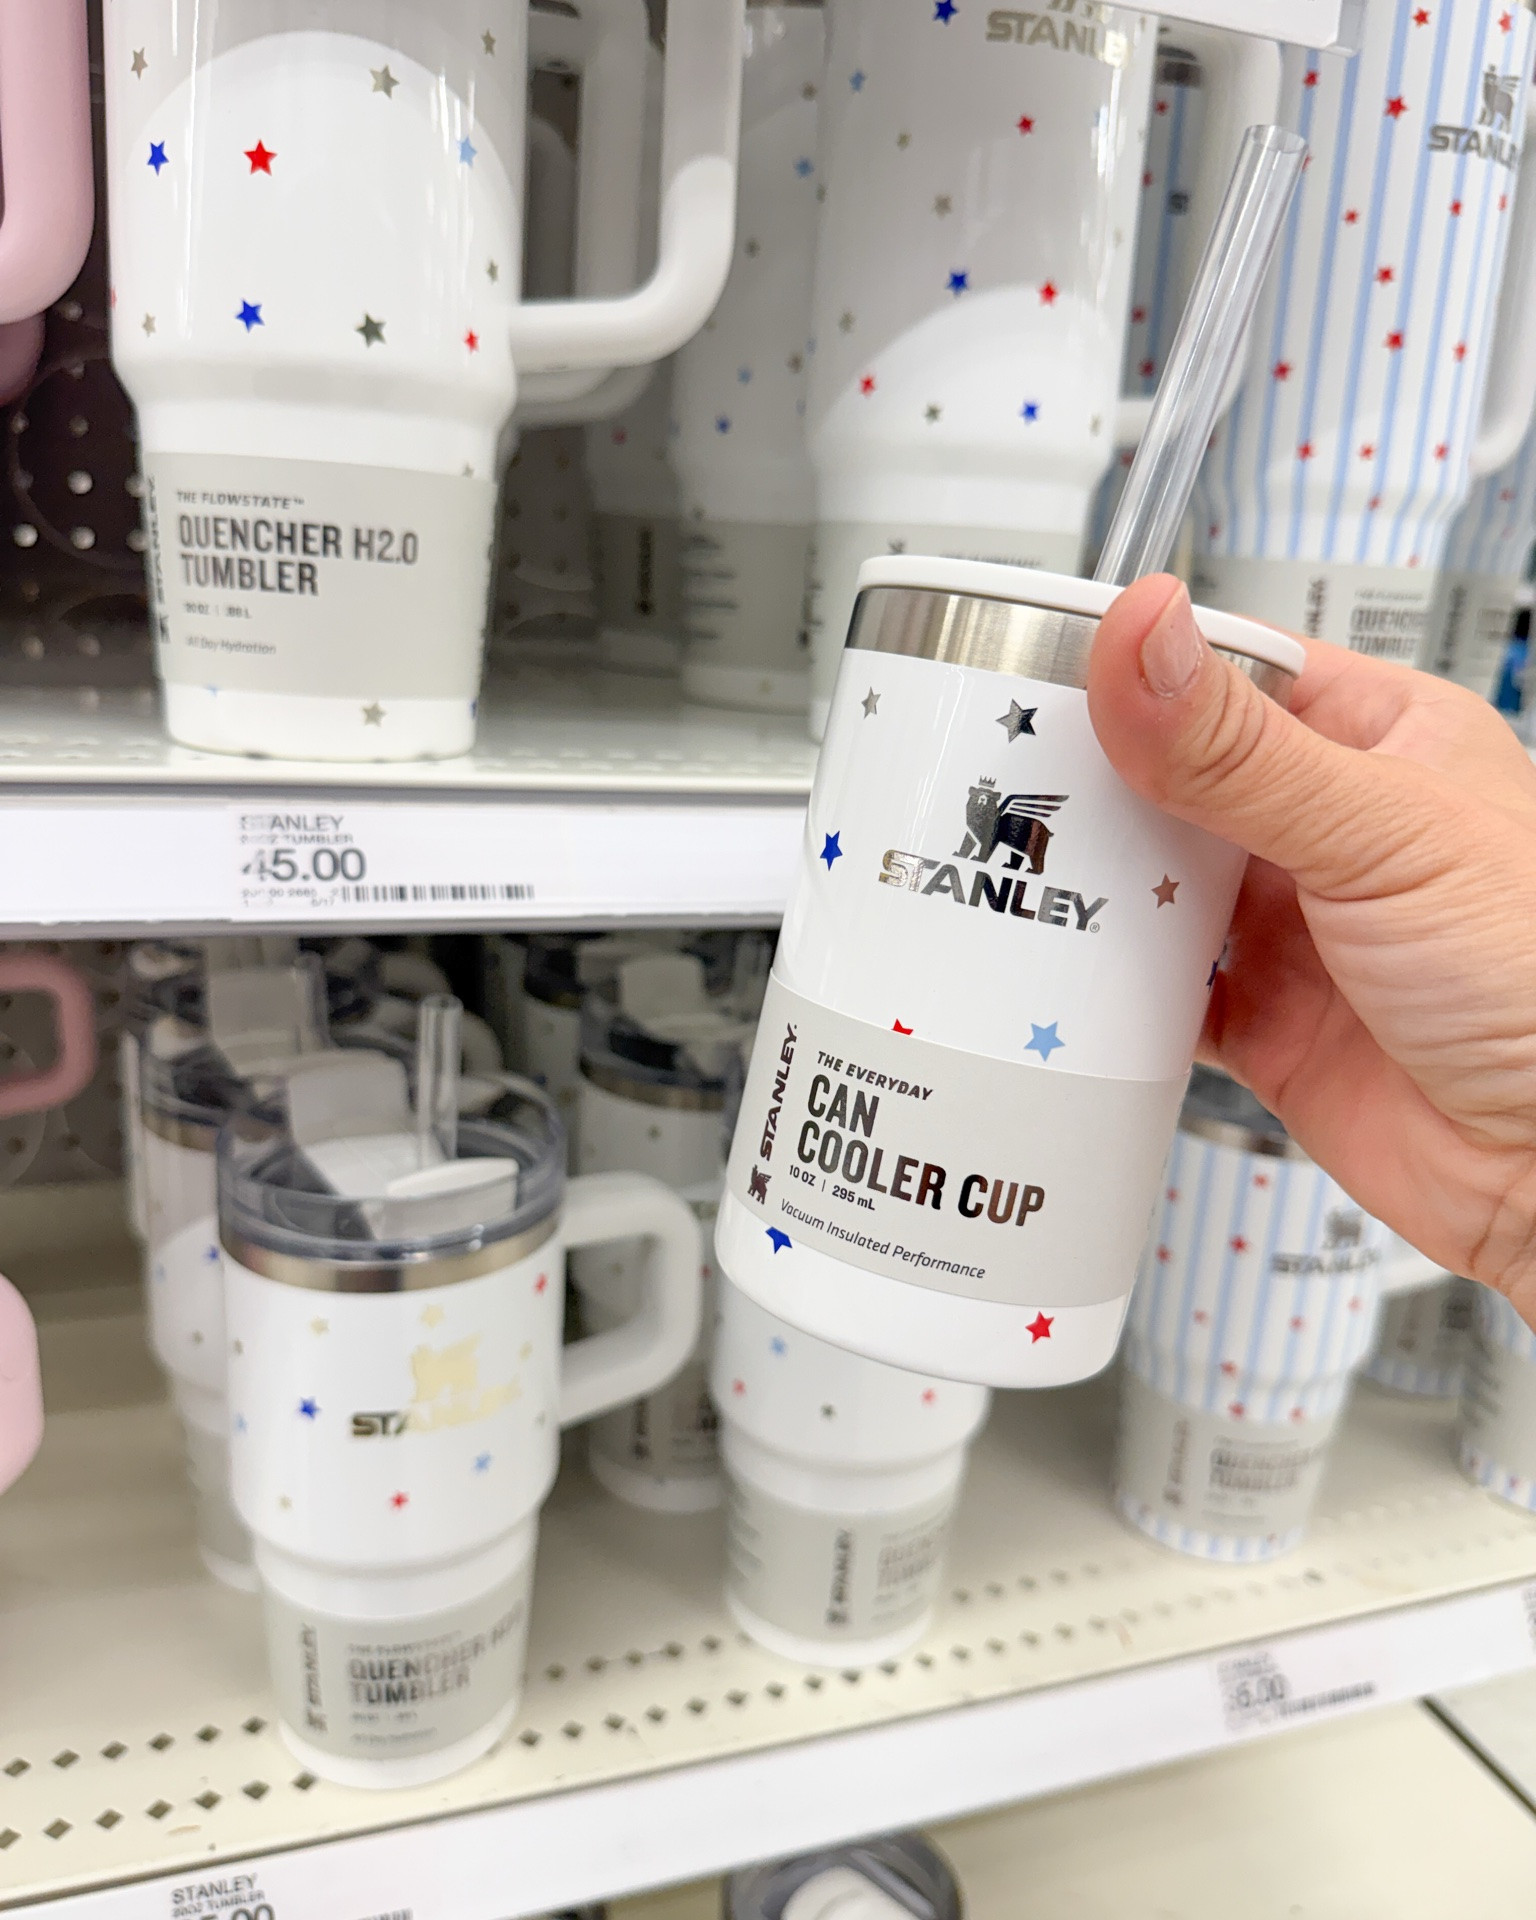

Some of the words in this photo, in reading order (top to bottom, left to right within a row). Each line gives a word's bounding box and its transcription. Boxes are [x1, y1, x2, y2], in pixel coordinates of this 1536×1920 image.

[177, 490, 197, 504] THE
[179, 514, 343, 559] QUENCHER
[353, 525, 419, 565] H2.0
[180, 553, 319, 597] TUMBLER
[221, 639, 277, 655] Hydration
[817, 1050, 843, 1073] THE
[845, 1063, 934, 1101] EVERYDAY
[807, 1073, 880, 1138] CAN
[789, 1164, 801, 1178] 10
[801, 1172, 816, 1187] OZ
[831, 1184, 855, 1203] 295
[857, 1196, 876, 1211] mL
[797, 1120, 947, 1210] COOLER
[957, 1173, 1046, 1227] CUP
[781, 1198, 825, 1231] Vacuum
[826, 1217, 891, 1256] Insulated
[892, 1245, 986, 1280] Performance
[170, 1873, 258, 1905] STANLEY
